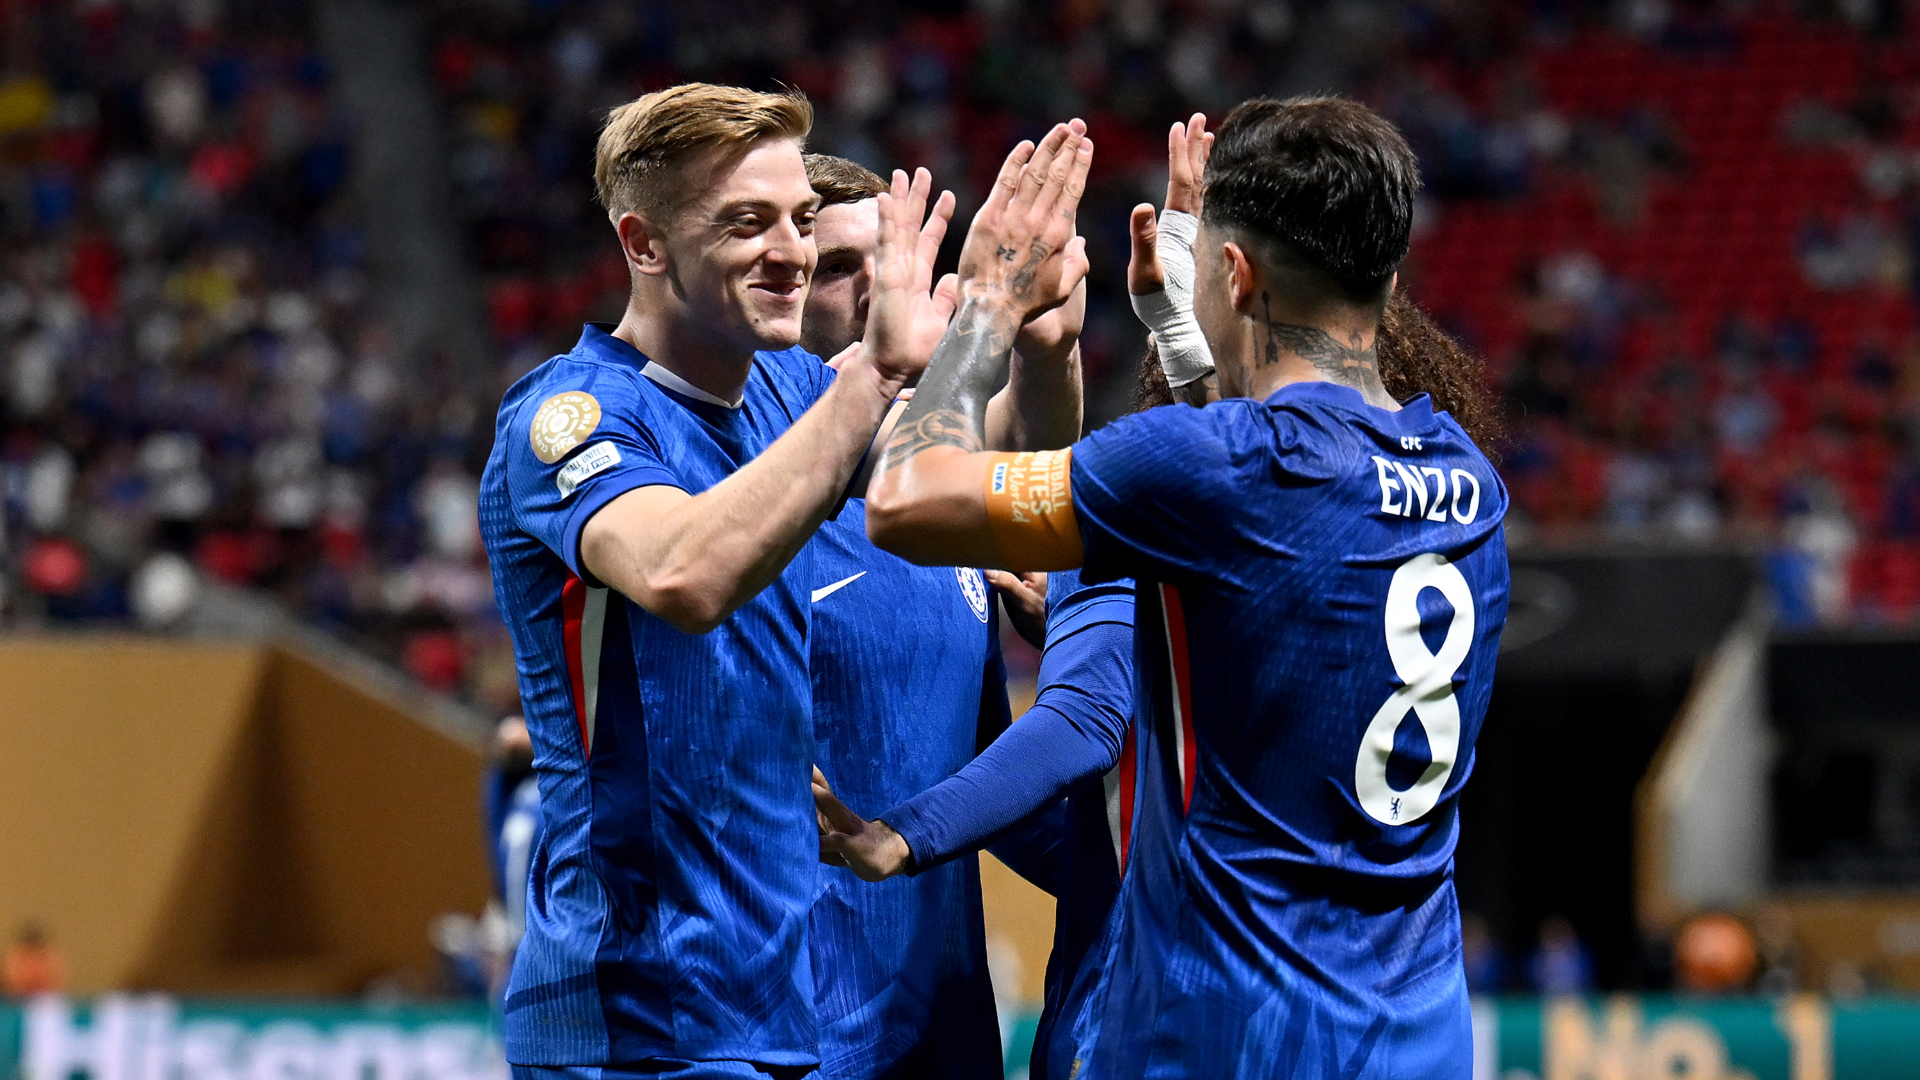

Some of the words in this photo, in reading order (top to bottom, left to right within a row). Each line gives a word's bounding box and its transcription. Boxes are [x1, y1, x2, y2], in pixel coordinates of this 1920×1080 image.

[535, 398, 562, 432] WORLD
[563, 395, 584, 404] CUP
[577, 413, 592, 431] USA
[551, 435, 578, 457] FIFA
[1400, 436, 1423, 450] CFC
[994, 465, 1005, 492] FIFA
[1008, 466, 1031, 523] World
[1371, 455, 1480, 525] ENZO
[1355, 553, 1475, 826] 8
[22, 992, 510, 1080] Hisens
